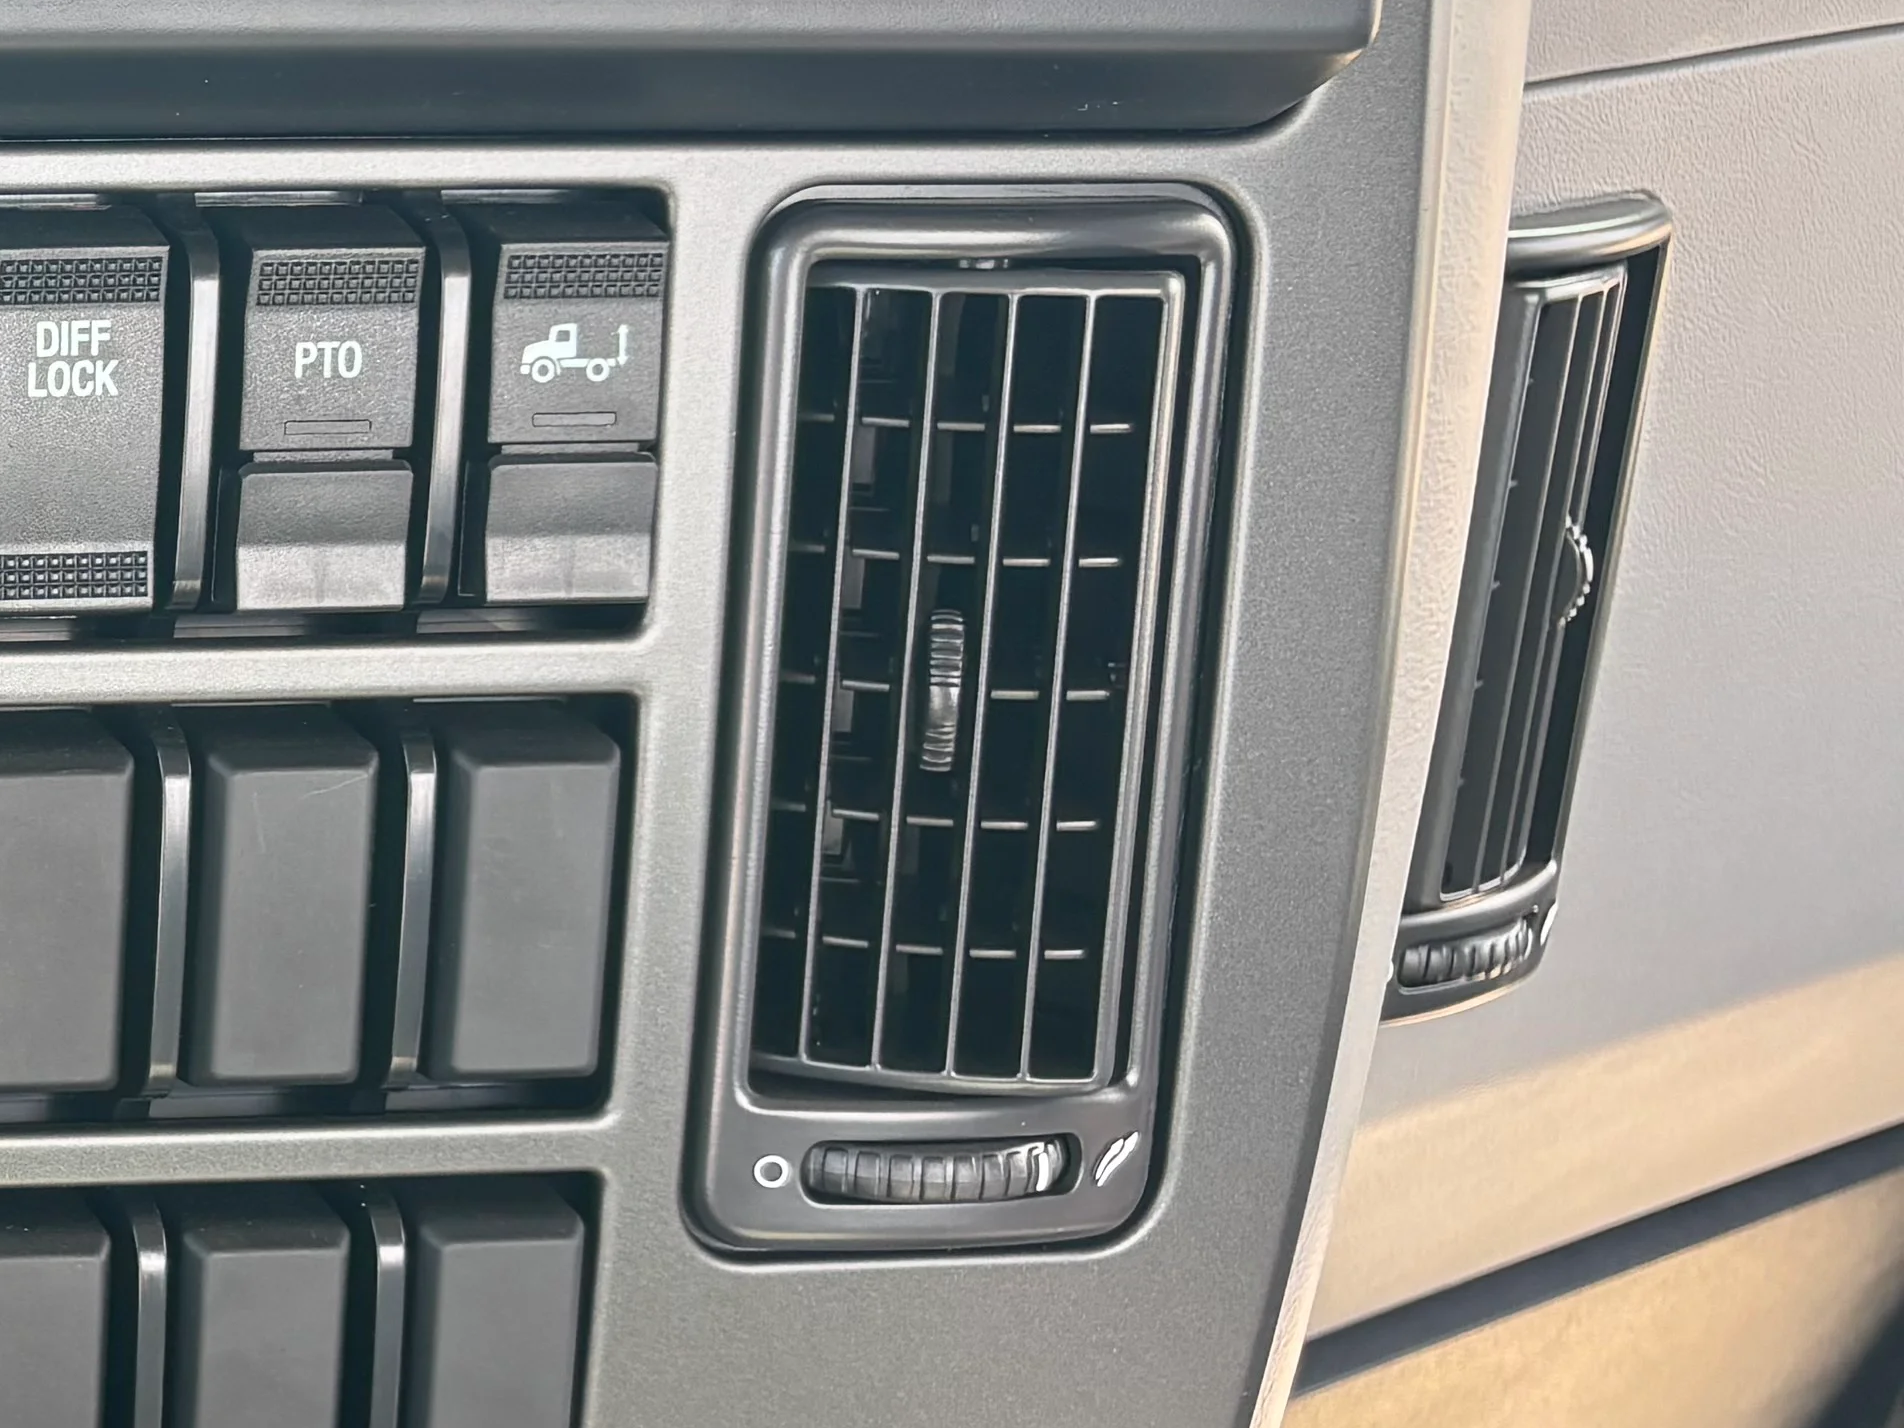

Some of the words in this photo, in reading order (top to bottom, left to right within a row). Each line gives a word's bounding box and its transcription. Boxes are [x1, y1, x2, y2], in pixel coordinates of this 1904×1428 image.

[36, 317, 115, 358] DIFF
[27, 359, 120, 399] LOCK
[294, 340, 363, 380] PTO
